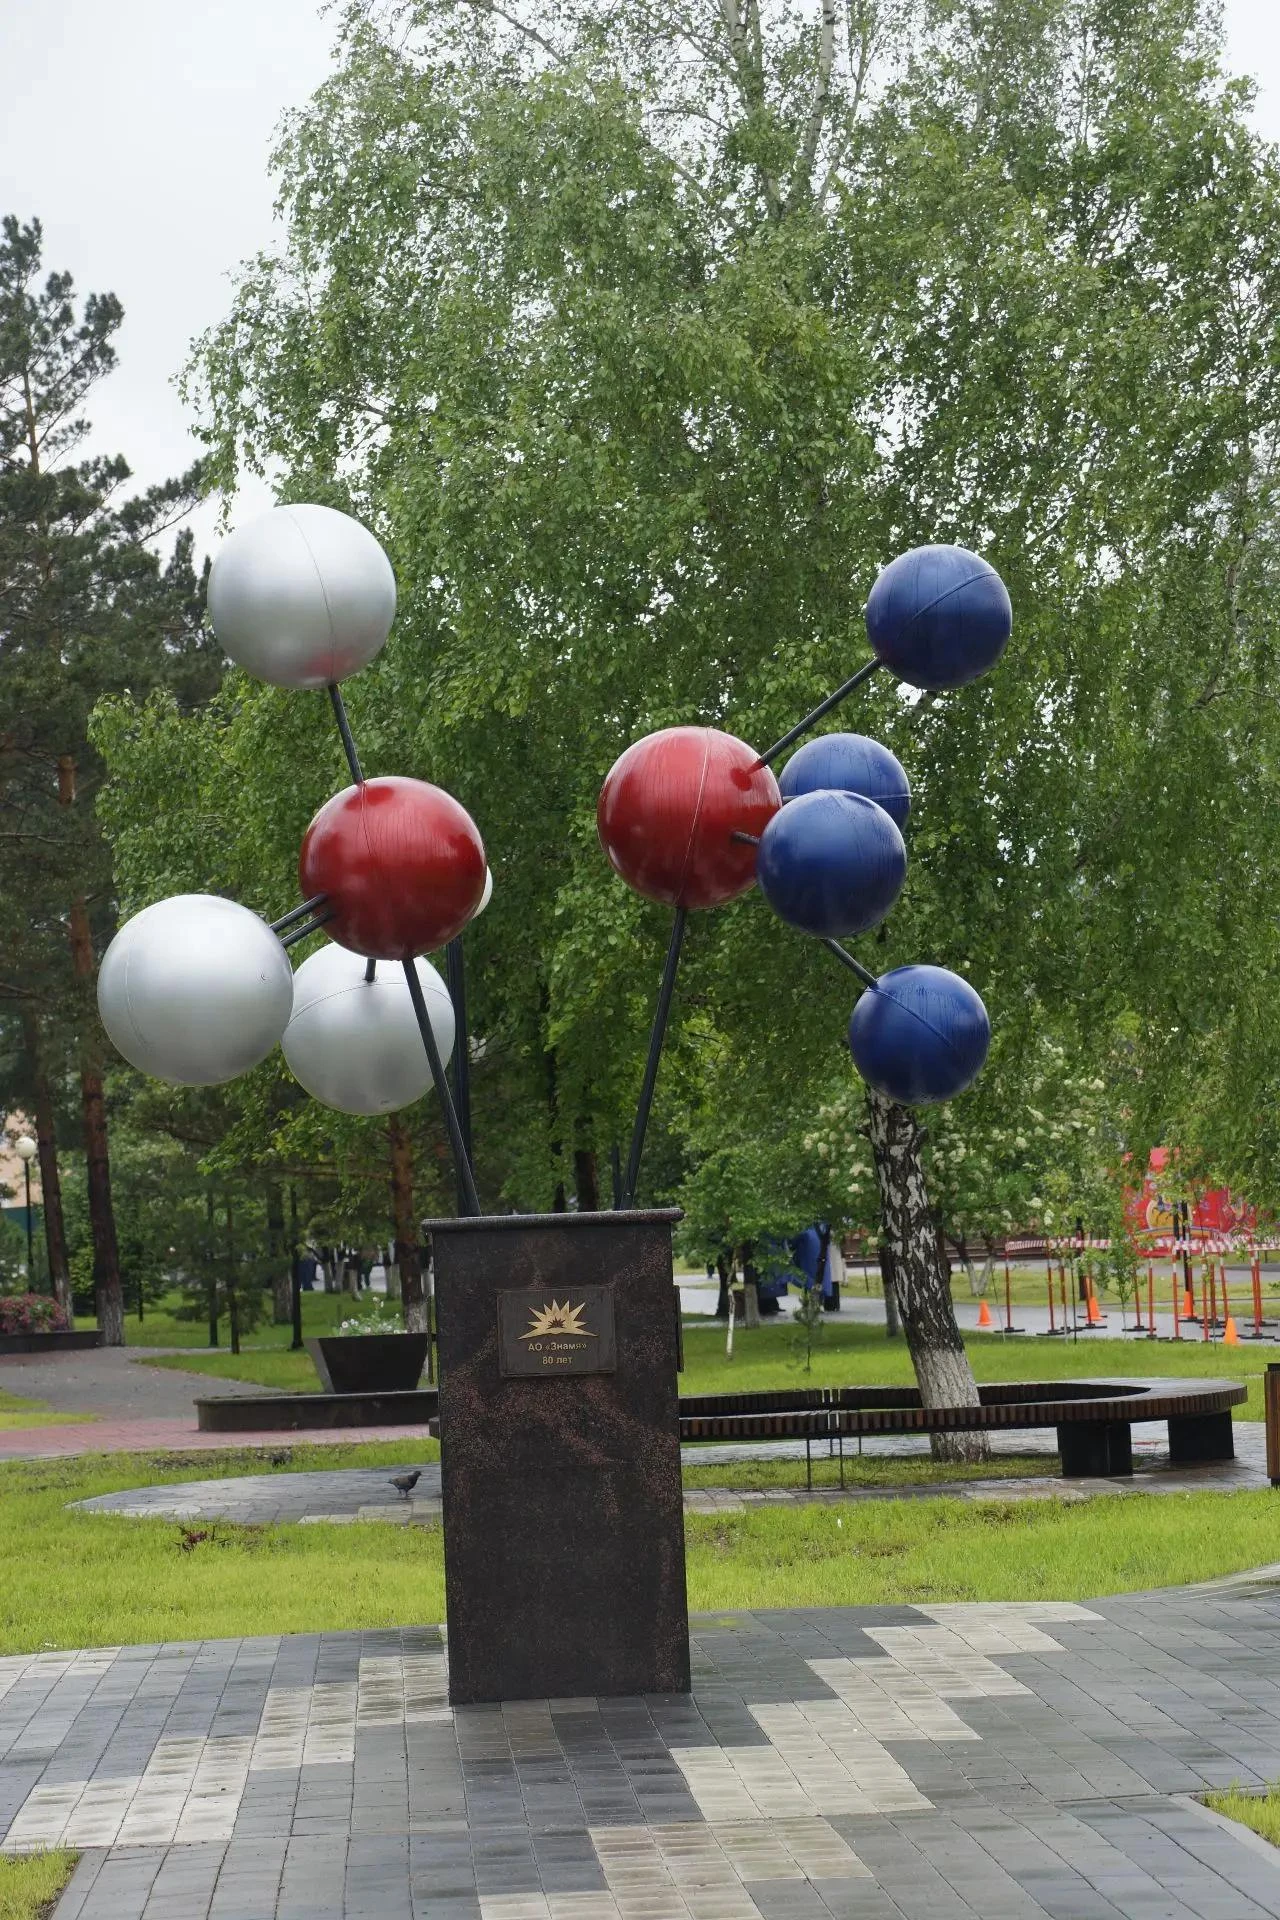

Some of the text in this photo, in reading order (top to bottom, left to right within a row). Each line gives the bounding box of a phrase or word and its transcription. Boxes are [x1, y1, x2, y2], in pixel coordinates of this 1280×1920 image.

[528, 1341, 587, 1351] АО «Знамя»
[542, 1356, 573, 1365] 80 лет
